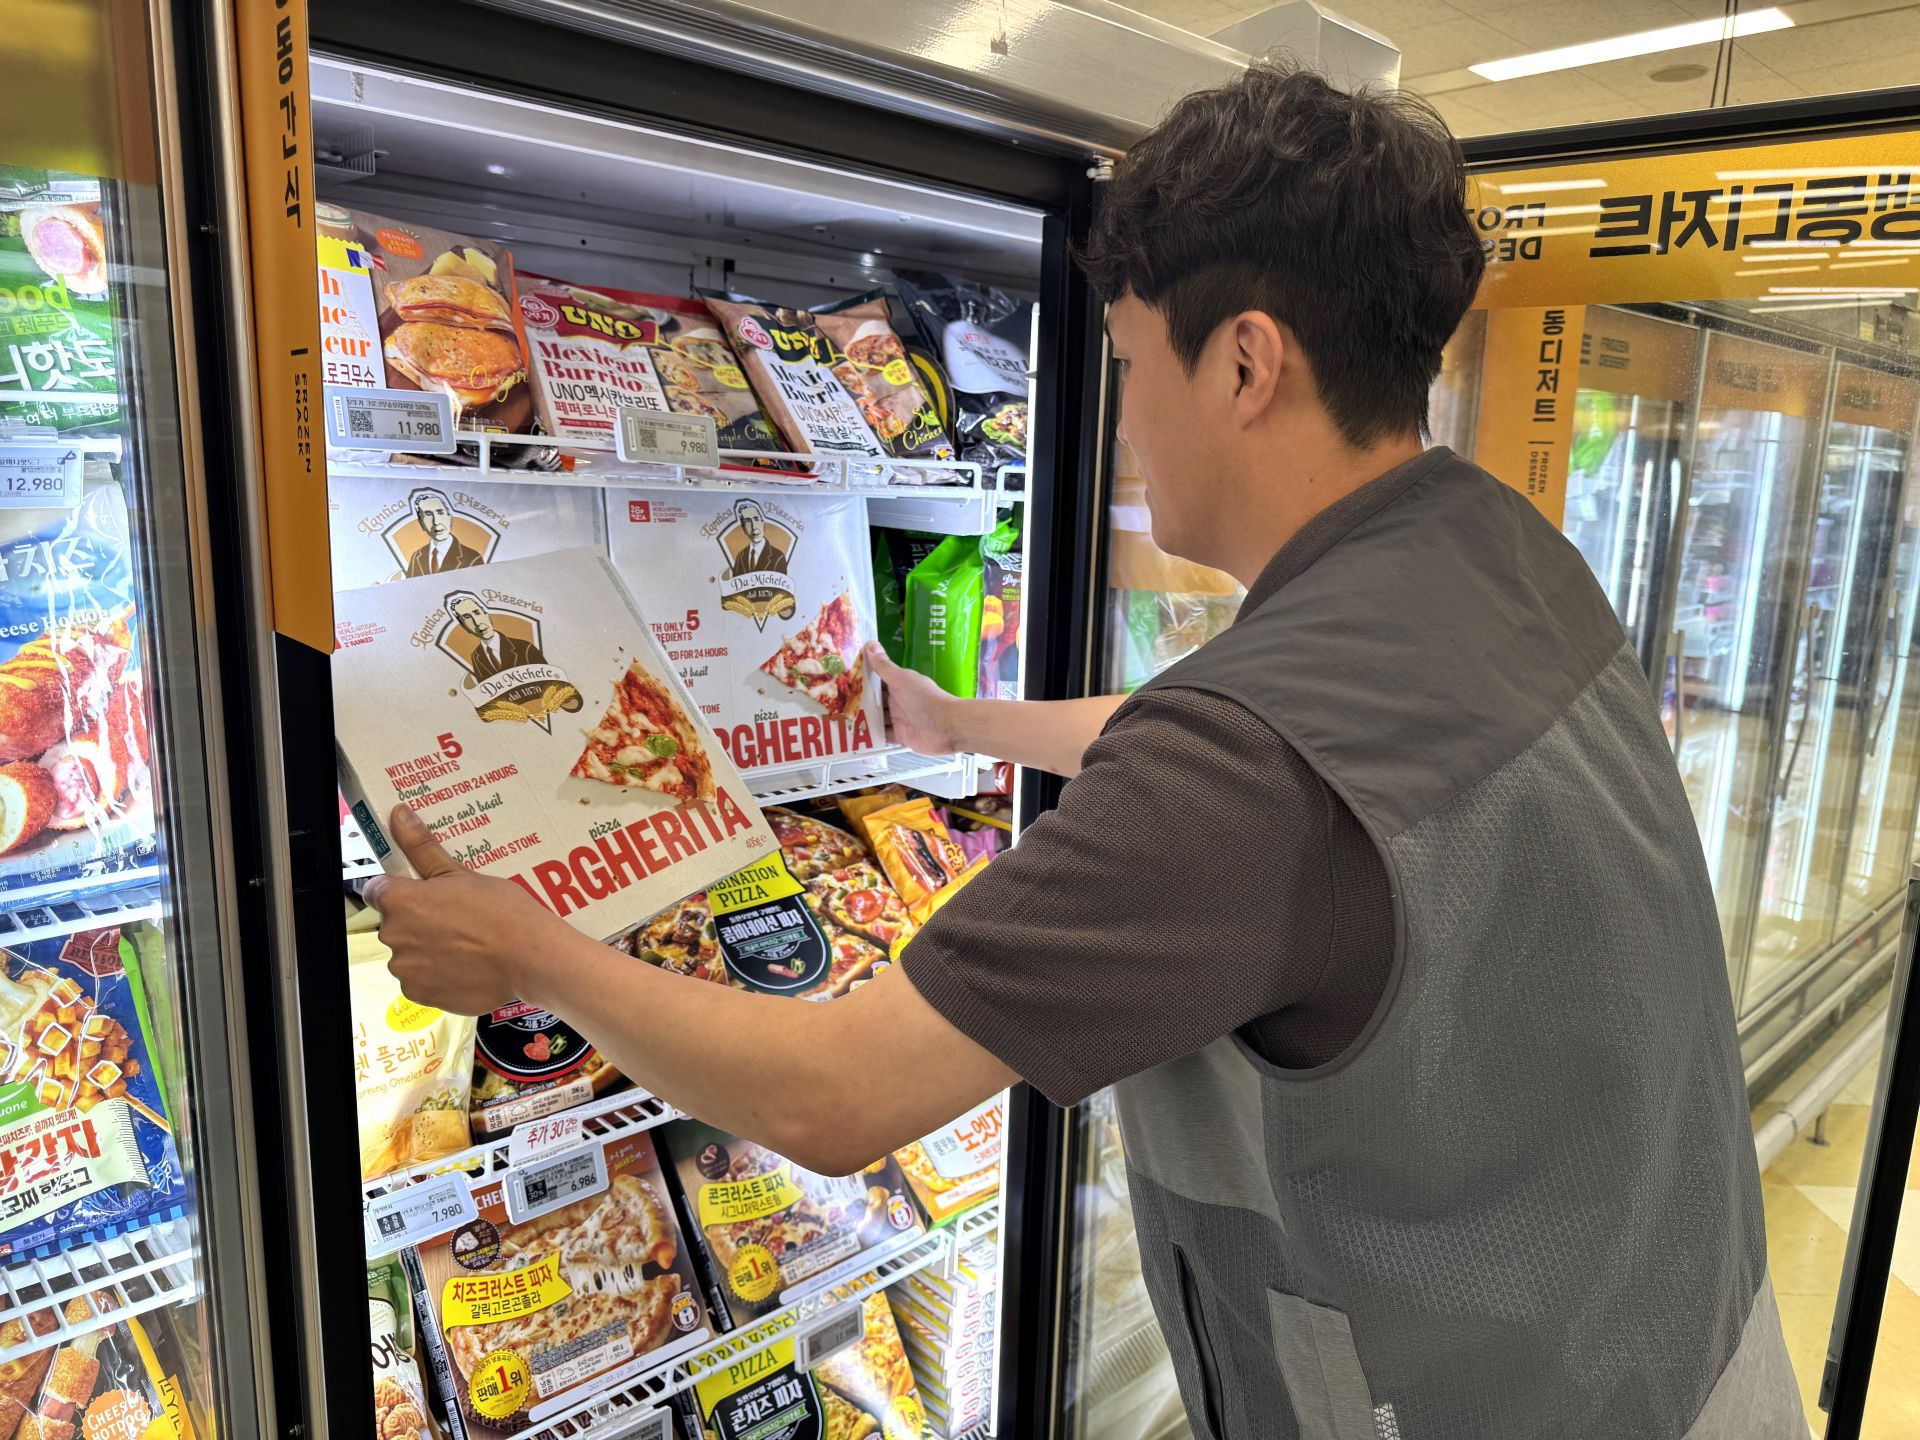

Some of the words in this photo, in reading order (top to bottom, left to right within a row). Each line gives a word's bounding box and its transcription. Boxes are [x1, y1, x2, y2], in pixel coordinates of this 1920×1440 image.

[275, 0, 301, 228] 동간식
[0, 272, 72, 313] ood
[559, 304, 644, 341] UNO
[536, 340, 648, 374] Mexican
[322, 362, 376, 388] 로크무슈
[543, 359, 644, 393] Burrito
[549, 381, 662, 412] UNO멕시칸브리또
[294, 374, 304, 457] SNACK
[301, 373, 311, 474] FROZEN
[398, 421, 440, 436] 11.980
[680, 440, 707, 454] 9.980
[6, 477, 63, 492] 12.980
[1527, 451, 1539, 497] DESSERT
[1538, 451, 1549, 494] FROZEN
[453, 491, 511, 530] Pizzeria
[731, 577, 749, 591] Da
[750, 573, 787, 587] Michele
[481, 588, 544, 614] Pizzeria
[0, 621, 40, 638] eese
[663, 622, 685, 632] ONLY
[686, 609, 701, 631] 5
[928, 604, 947, 646] DELI
[656, 631, 693, 643] REDIENTS
[680, 650, 694, 660] FOR
[694, 648, 704, 659] 24
[704, 647, 728, 658] HOURS
[480, 680, 504, 698] Da
[502, 667, 553, 687] Michele
[690, 665, 709, 678] basil
[508, 690, 522, 702] dal
[521, 685, 542, 698] 1870
[701, 704, 721, 714] TONE
[754, 709, 779, 724] pizza
[713, 709, 873, 769] RGHERITA
[384, 761, 415, 779] WITH
[414, 751, 443, 772] ONLY
[436, 732, 463, 759] 5
[391, 760, 461, 791] INGREDIENTS
[398, 780, 432, 802] dough
[407, 787, 454, 812] EAVENED
[453, 780, 474, 797] FOR
[472, 776, 487, 790] 24
[485, 763, 519, 785] HOURS
[426, 814, 454, 833] mato
[457, 803, 476, 821] and
[476, 792, 504, 812] basil
[433, 831, 451, 844] 0%
[449, 813, 492, 838] ITALIAN
[588, 817, 622, 842] pizza
[453, 839, 493, 863] d-fired
[463, 846, 510, 872] OLCANIC
[507, 832, 542, 854] STONE
[507, 786, 753, 918] ARGHERITA
[707, 865, 780, 893] MBINATION
[717, 884, 770, 908] PIZZA
[720, 917, 781, 945] 콤비네이션
[776, 908, 804, 928] 피자
[376, 1031, 437, 1074] 플레인
[357, 1084, 388, 1100] orning
[527, 1124, 549, 1149] 추가
[528, 1188, 544, 1200] 30%
[571, 1173, 596, 1192] 6.986
[708, 1180, 763, 1206] 콘크러스트
[763, 1173, 786, 1194] 피자
[431, 1203, 463, 1223] 7.980
[452, 1272, 527, 1303] 치즈크러스트
[528, 1263, 553, 1288] 피자
[727, 1347, 778, 1386] PIZZA
[476, 1383, 500, 1403] 판매
[496, 1365, 524, 1394] 1위
[729, 1395, 775, 1433] 콘치즈
[772, 1378, 804, 1408] 피자
